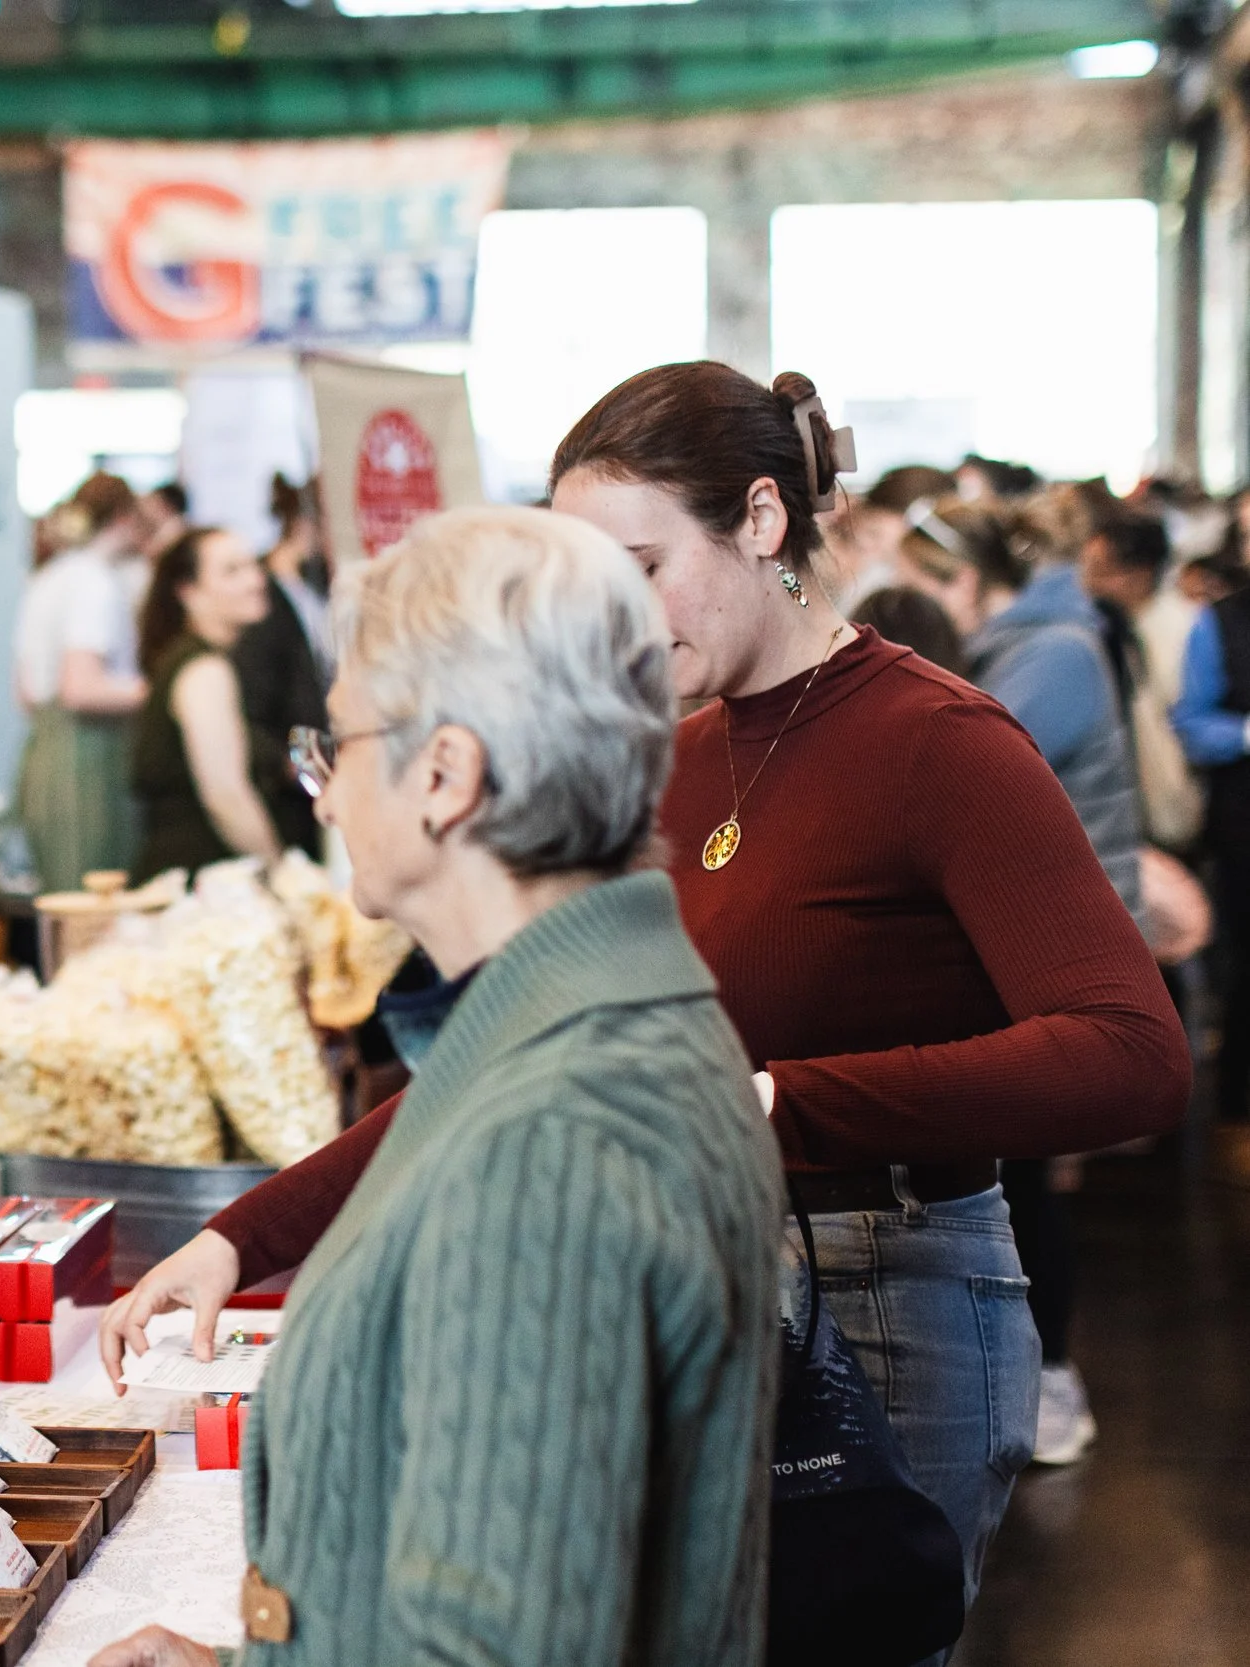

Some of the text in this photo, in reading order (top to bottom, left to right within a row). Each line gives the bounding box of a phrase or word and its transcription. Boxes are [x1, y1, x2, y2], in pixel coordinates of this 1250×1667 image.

[267, 186, 484, 258] FREE
[96, 180, 261, 344] G
[260, 256, 479, 332] FEST
[772, 1453, 846, 1475] TO NONE.
